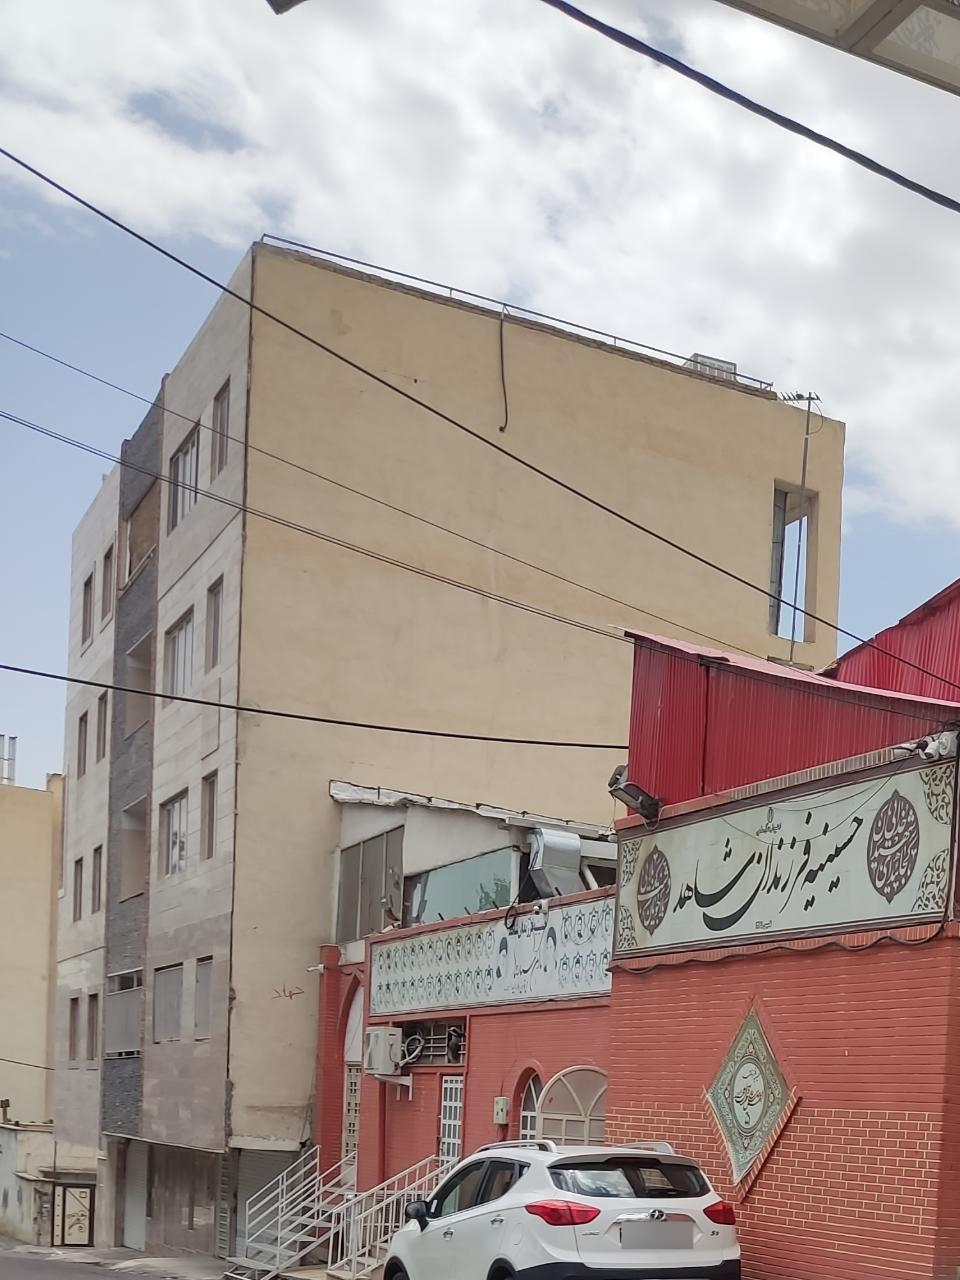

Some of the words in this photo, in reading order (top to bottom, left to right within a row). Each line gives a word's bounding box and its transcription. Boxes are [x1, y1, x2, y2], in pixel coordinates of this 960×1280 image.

[673, 837, 755, 913] شاهد
[702, 811, 811, 931] فرزندان
[802, 816, 864, 912] حسینیه
